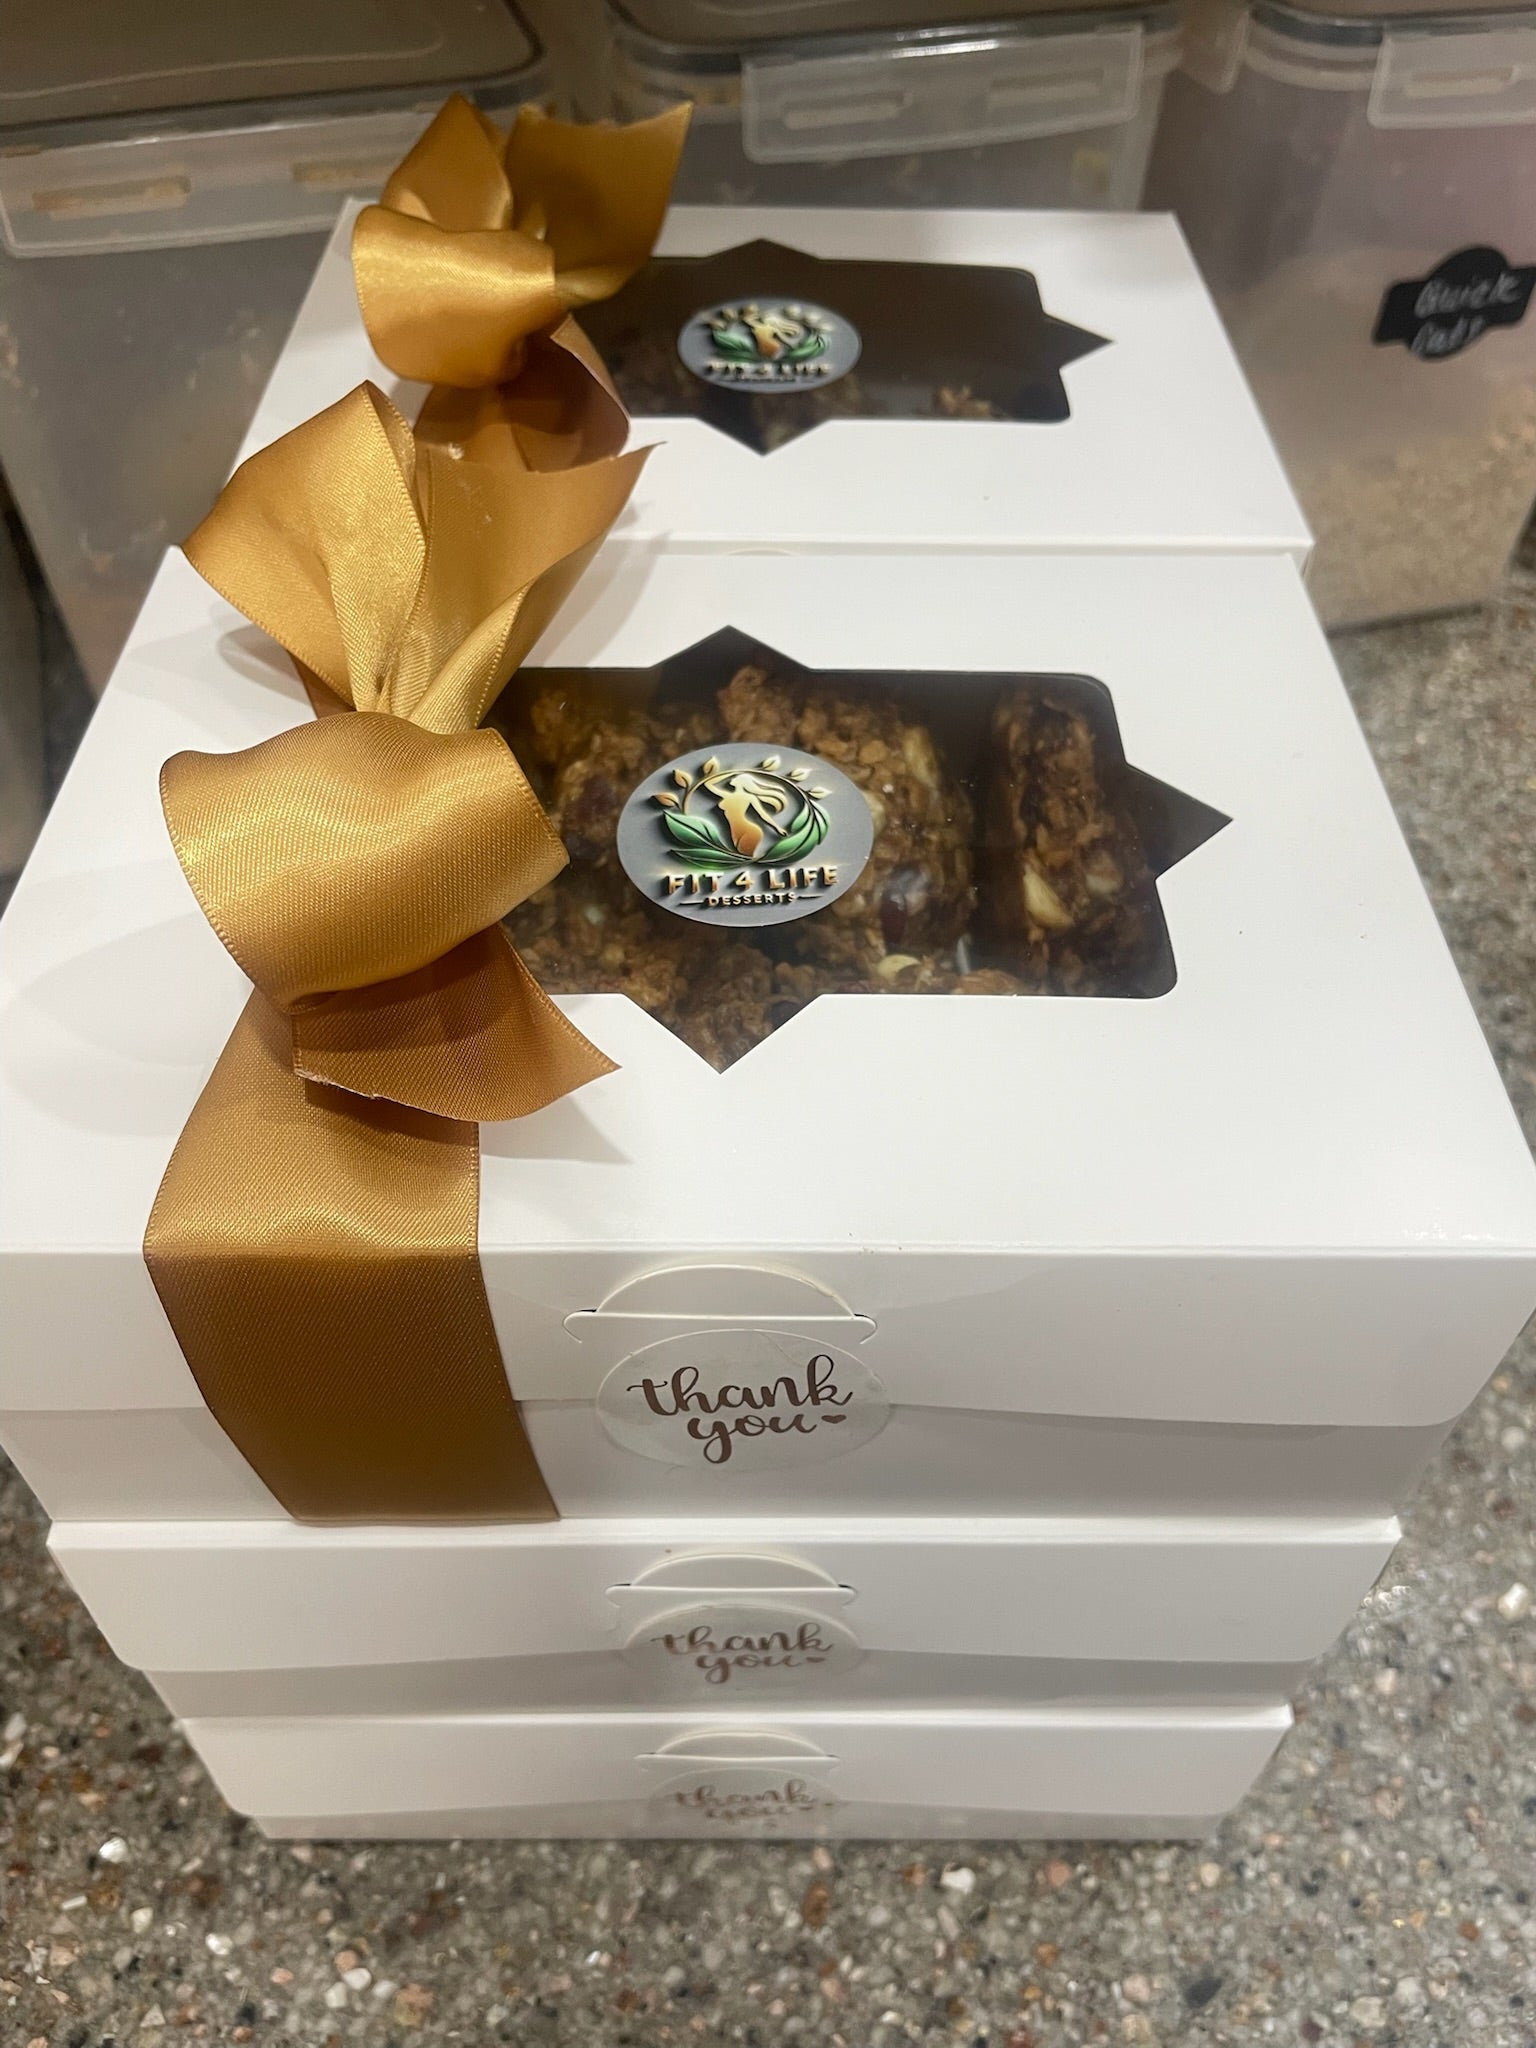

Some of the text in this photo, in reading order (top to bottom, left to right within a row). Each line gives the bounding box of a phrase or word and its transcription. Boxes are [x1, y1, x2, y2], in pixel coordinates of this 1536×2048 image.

[665, 865, 839, 895] FIT 4 LIFE
[708, 892, 797, 907] DESSERTS
[626, 1354, 853, 1416] thank
[687, 1414, 817, 1464] you
[650, 1622, 833, 1655] thank
[695, 1653, 801, 1684] you
